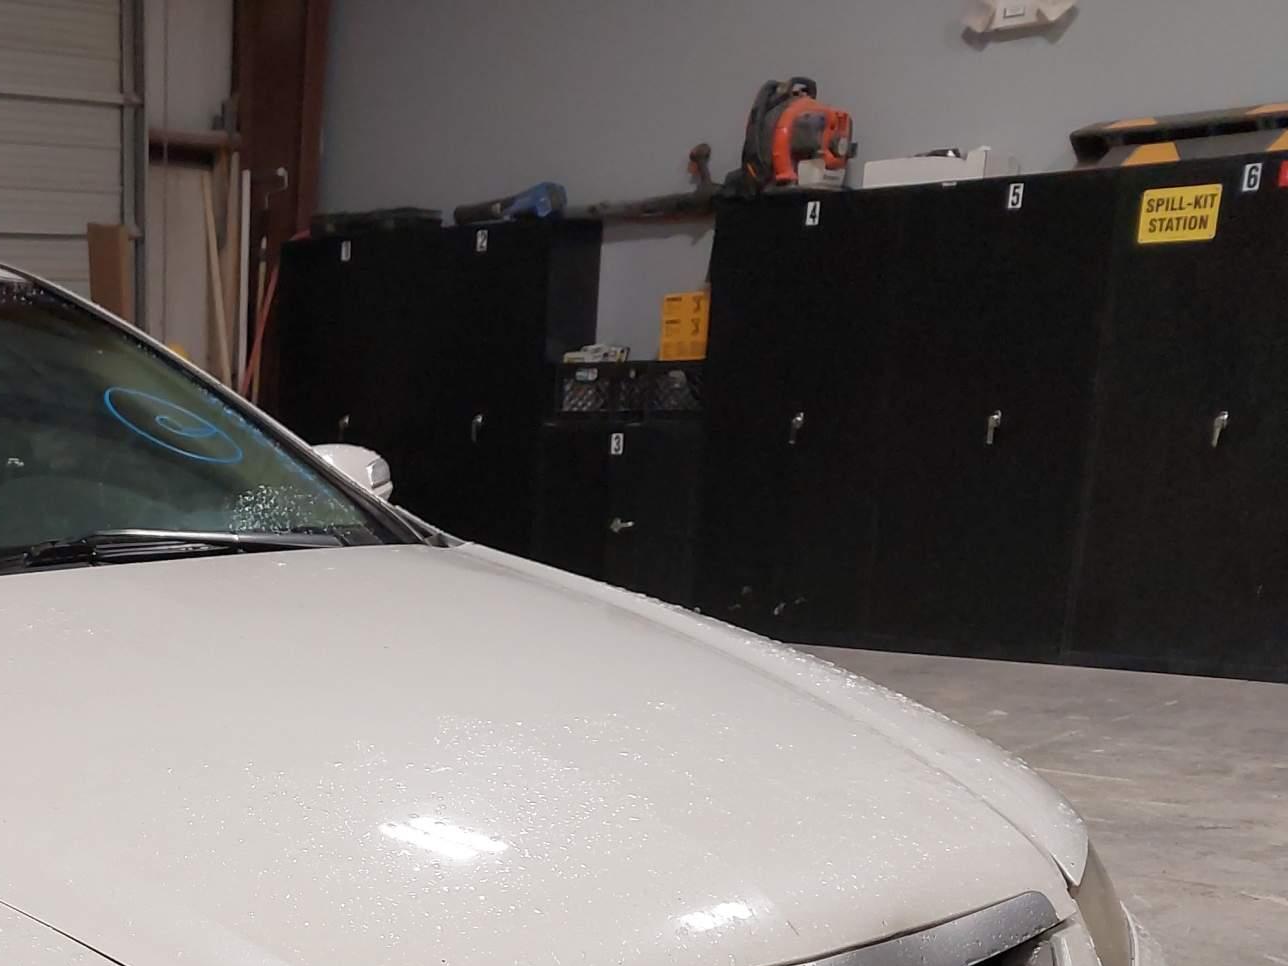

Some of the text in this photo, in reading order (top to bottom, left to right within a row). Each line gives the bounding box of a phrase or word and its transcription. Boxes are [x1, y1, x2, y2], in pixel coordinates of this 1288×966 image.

[1247, 165, 1259, 189] 6
[1010, 185, 1021, 206] 5
[1145, 193, 1219, 214] SPILL-KIT
[808, 203, 818, 224] 4
[1148, 214, 1210, 234] STATION
[479, 230, 488, 250] 2
[613, 434, 622, 453] 3
